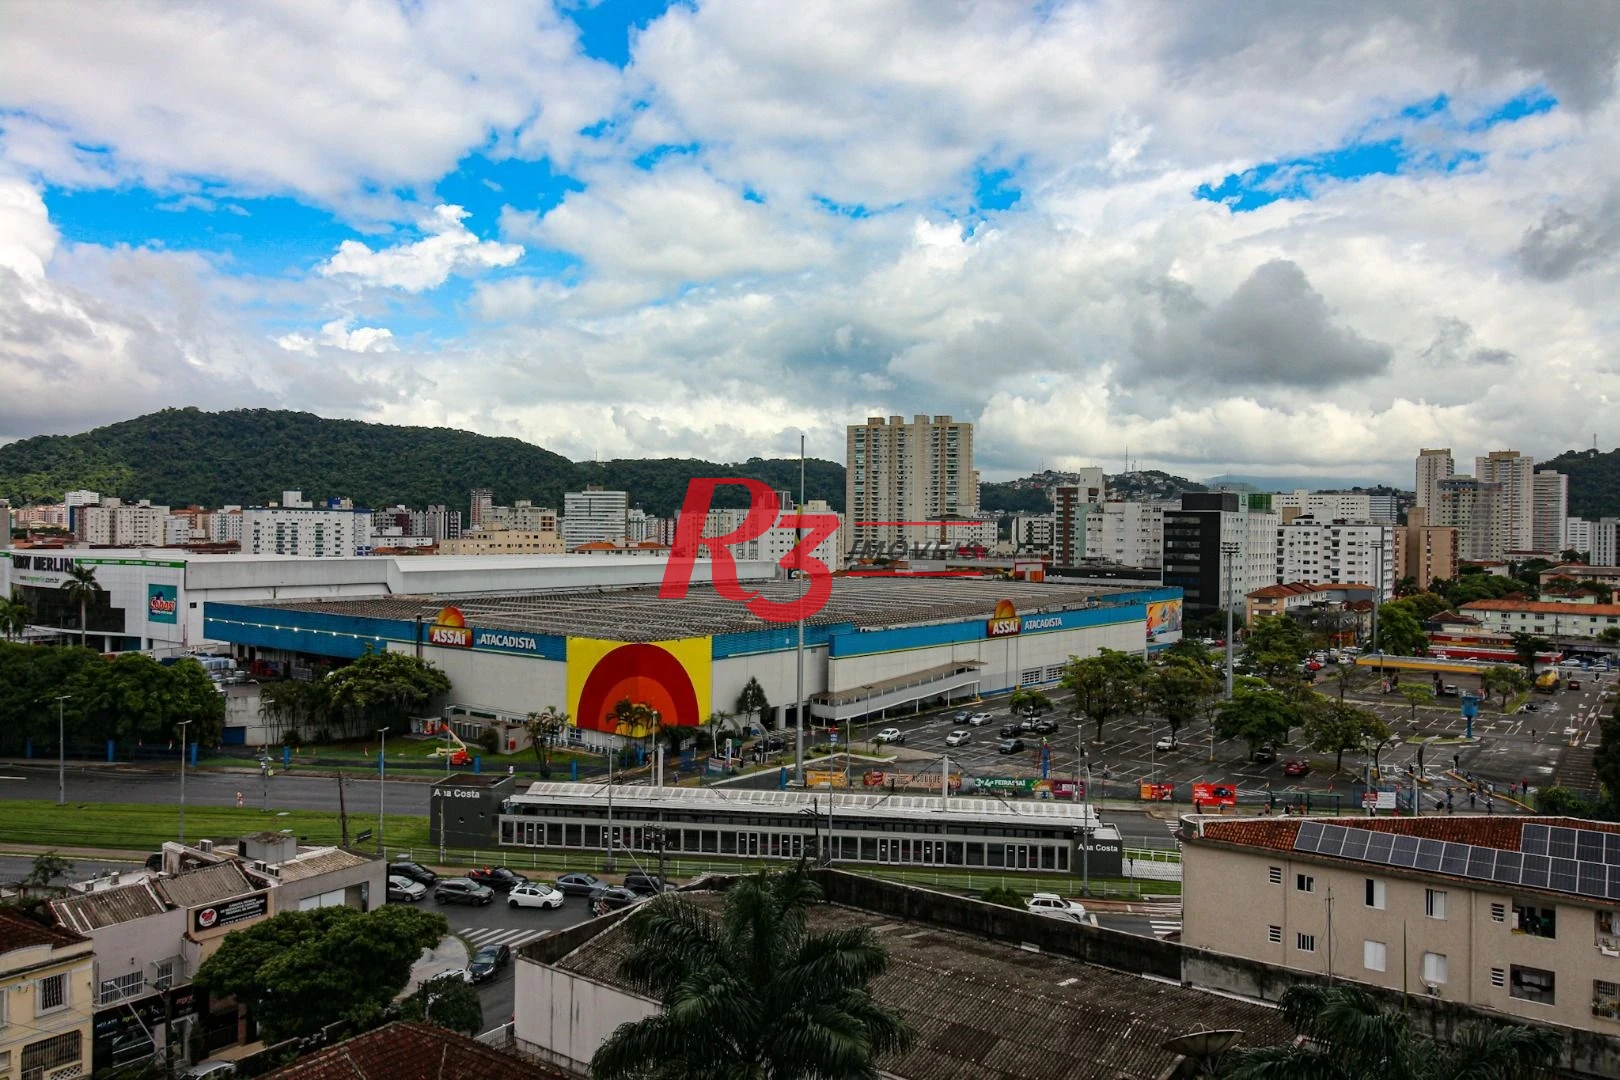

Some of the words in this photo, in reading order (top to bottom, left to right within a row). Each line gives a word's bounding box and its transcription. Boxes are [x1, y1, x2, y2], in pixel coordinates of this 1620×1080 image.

[33, 557, 74, 573] MERLIN
[1024, 617, 1062, 630] ATACADISTA
[480, 634, 537, 649] ATACADISTA
[454, 789, 480, 798] Costa
[1096, 844, 1118, 852] Costa
